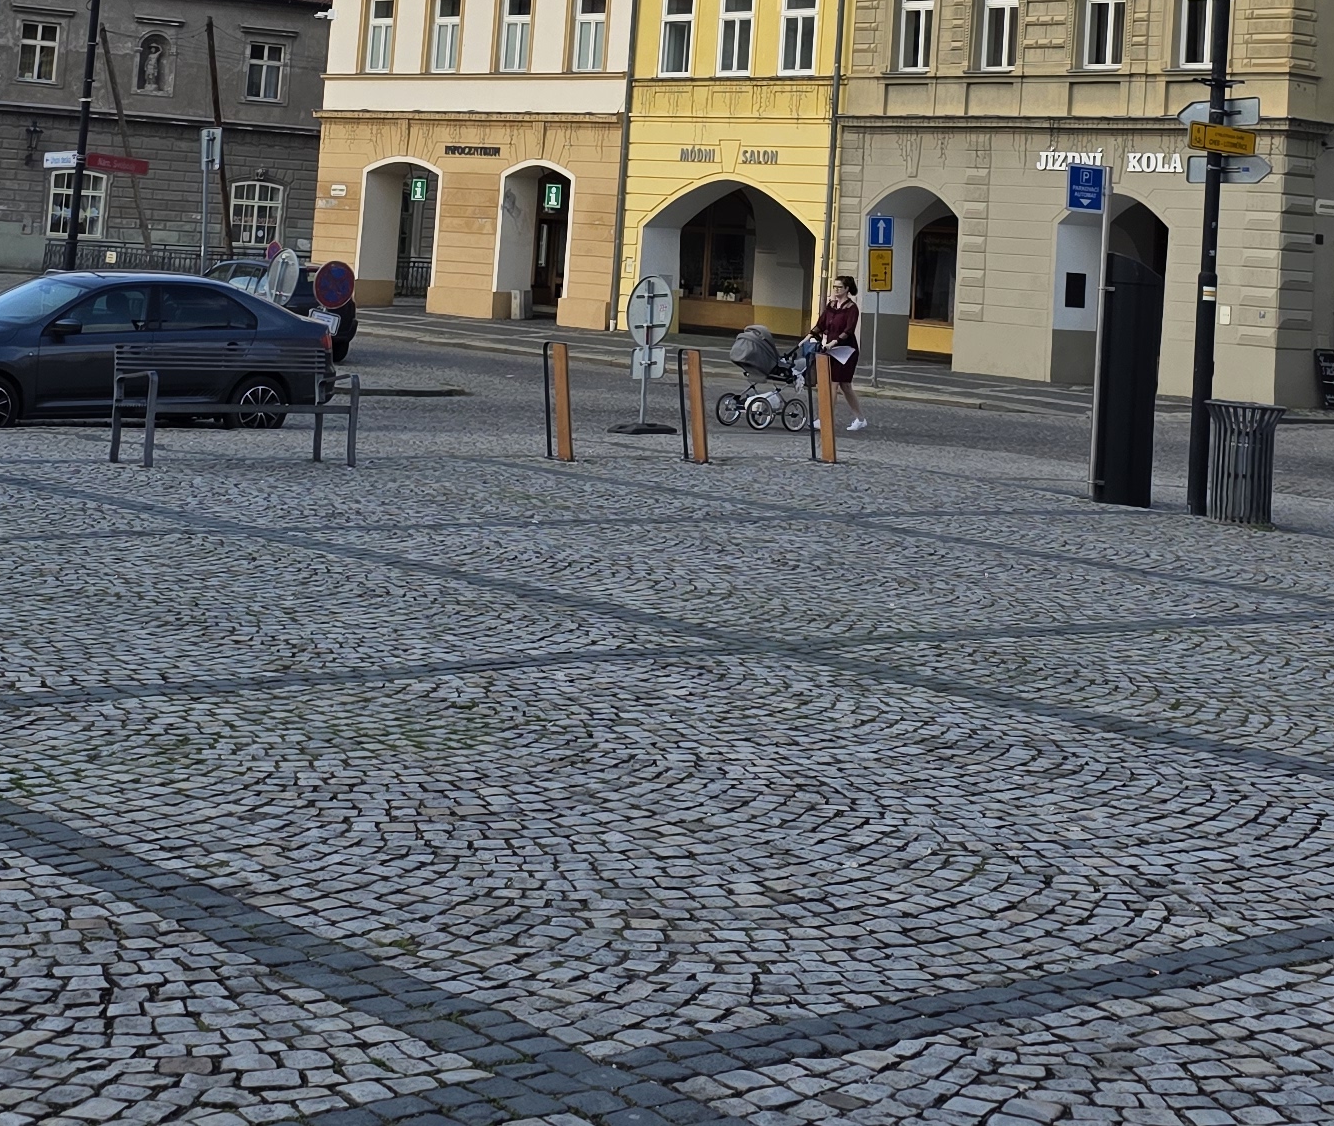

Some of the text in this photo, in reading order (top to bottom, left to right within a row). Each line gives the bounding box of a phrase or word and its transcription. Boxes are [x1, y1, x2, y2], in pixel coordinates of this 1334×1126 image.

[445, 145, 501, 157] INFOCENTRUM
[741, 149, 779, 164] SALON
[1036, 146, 1184, 173] JÍZDNÍ KOLA
[1083, 171, 1090, 183] P
